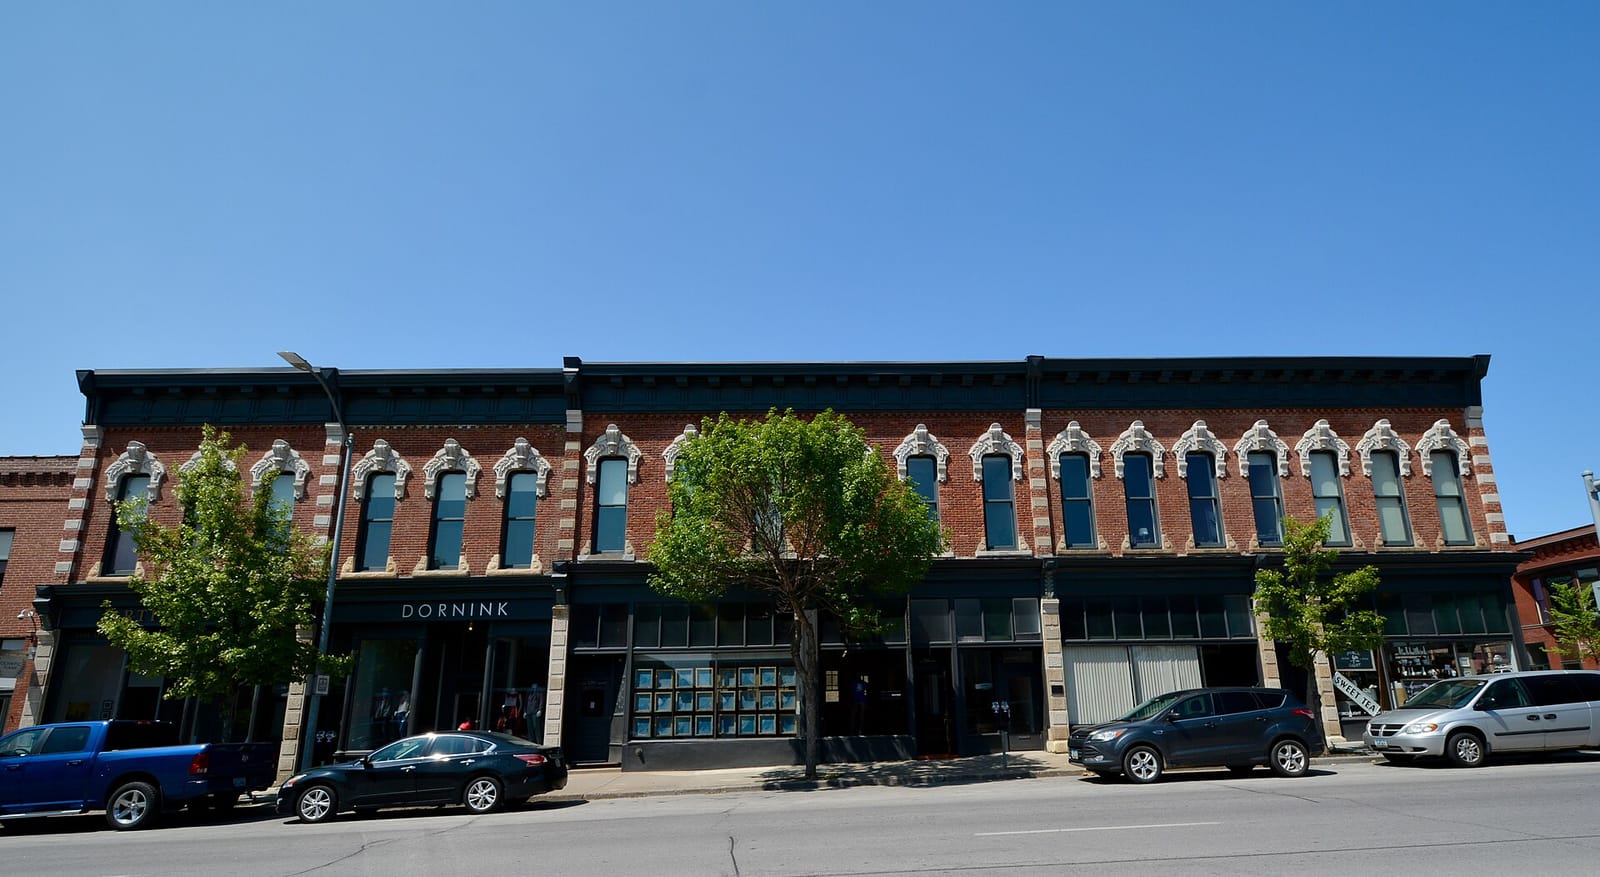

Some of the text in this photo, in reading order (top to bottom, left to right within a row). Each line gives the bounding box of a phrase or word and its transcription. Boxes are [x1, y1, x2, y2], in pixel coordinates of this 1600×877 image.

[402, 602, 508, 618] DORNINK
[1335, 677, 1376, 712] SWEET TEA
